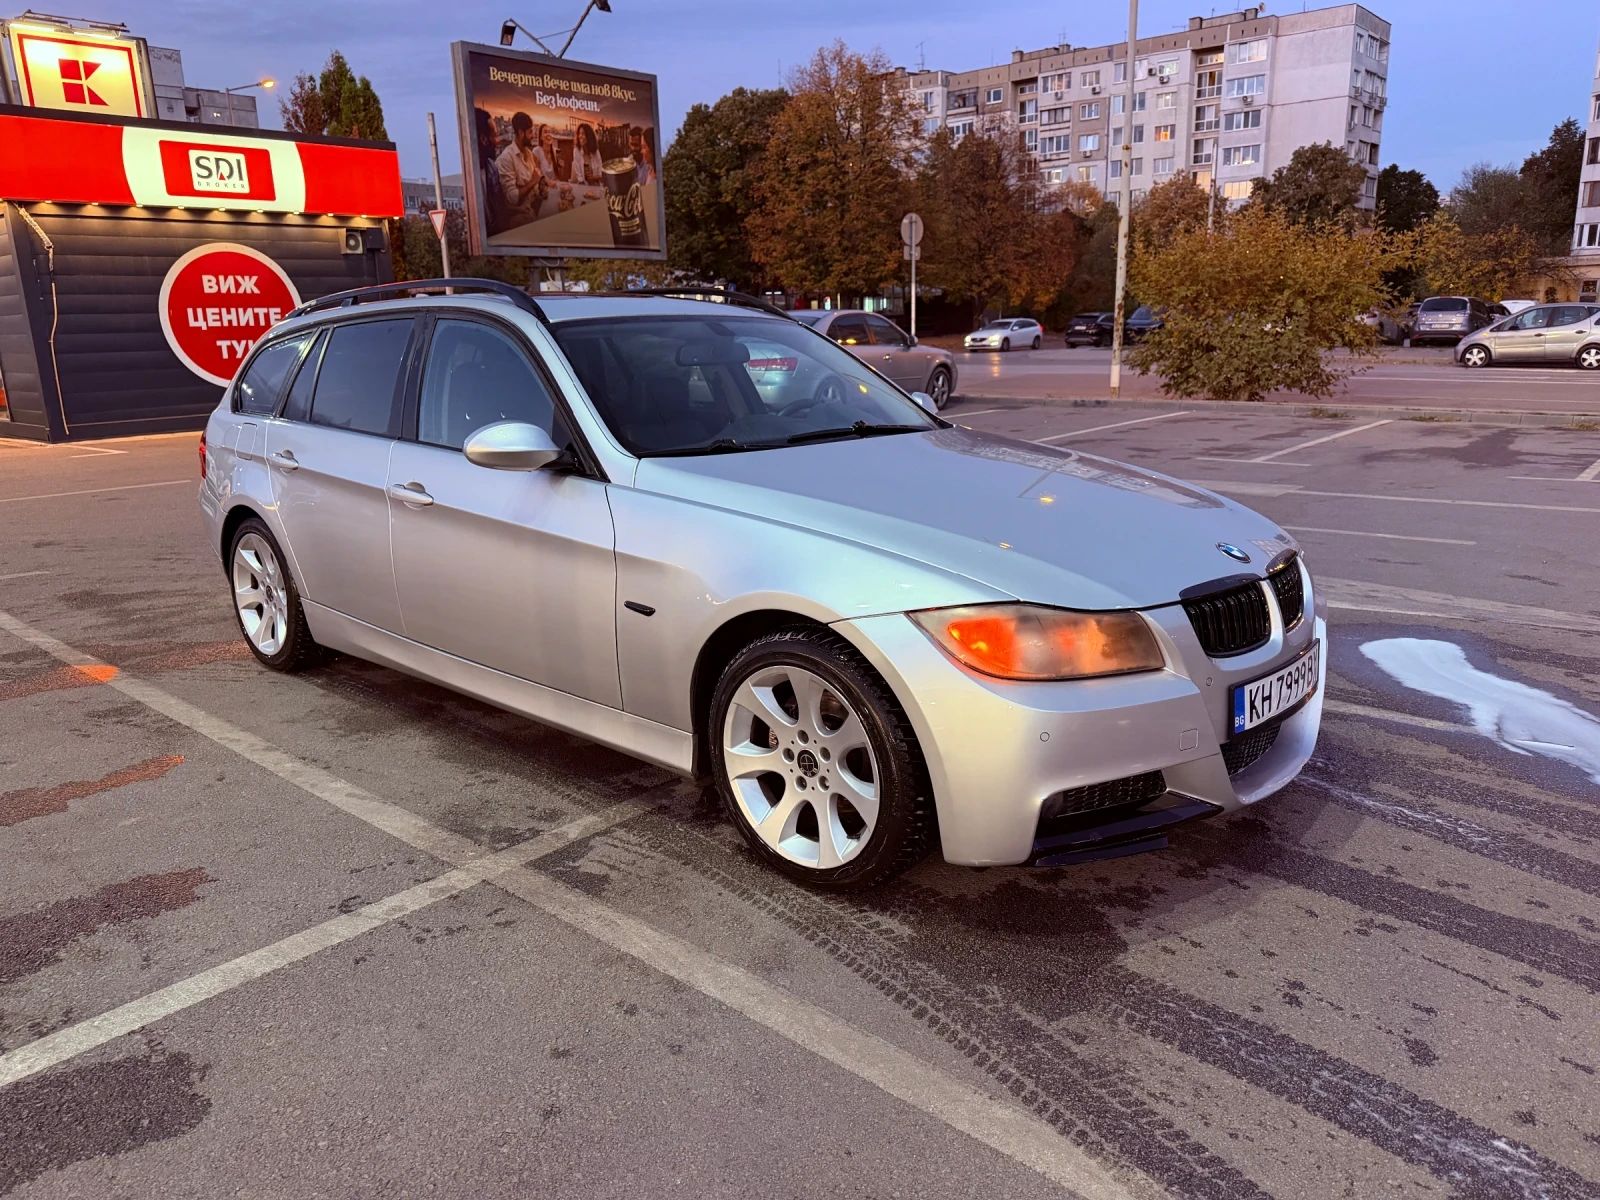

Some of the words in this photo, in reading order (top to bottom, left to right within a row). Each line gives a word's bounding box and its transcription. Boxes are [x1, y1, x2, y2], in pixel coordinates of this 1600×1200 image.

[489, 66, 543, 88] Вечерта
[543, 74, 570, 92] вече
[570, 81, 591, 94] има
[591, 83, 611, 97] нов
[611, 84, 637, 103] вкус.
[535, 90, 556, 110] Без
[556, 92, 600, 112] кофеин.
[194, 155, 244, 182] SDI
[197, 180, 246, 190] BROKER
[201, 274, 261, 294] ВИЖ
[186, 307, 282, 331] ЦЕНИТЕ
[216, 339, 256, 360] ТУ
[1249, 680, 1273, 723] KH
[1276, 660, 1307, 710] 7999
[1234, 714, 1245, 728] BG
